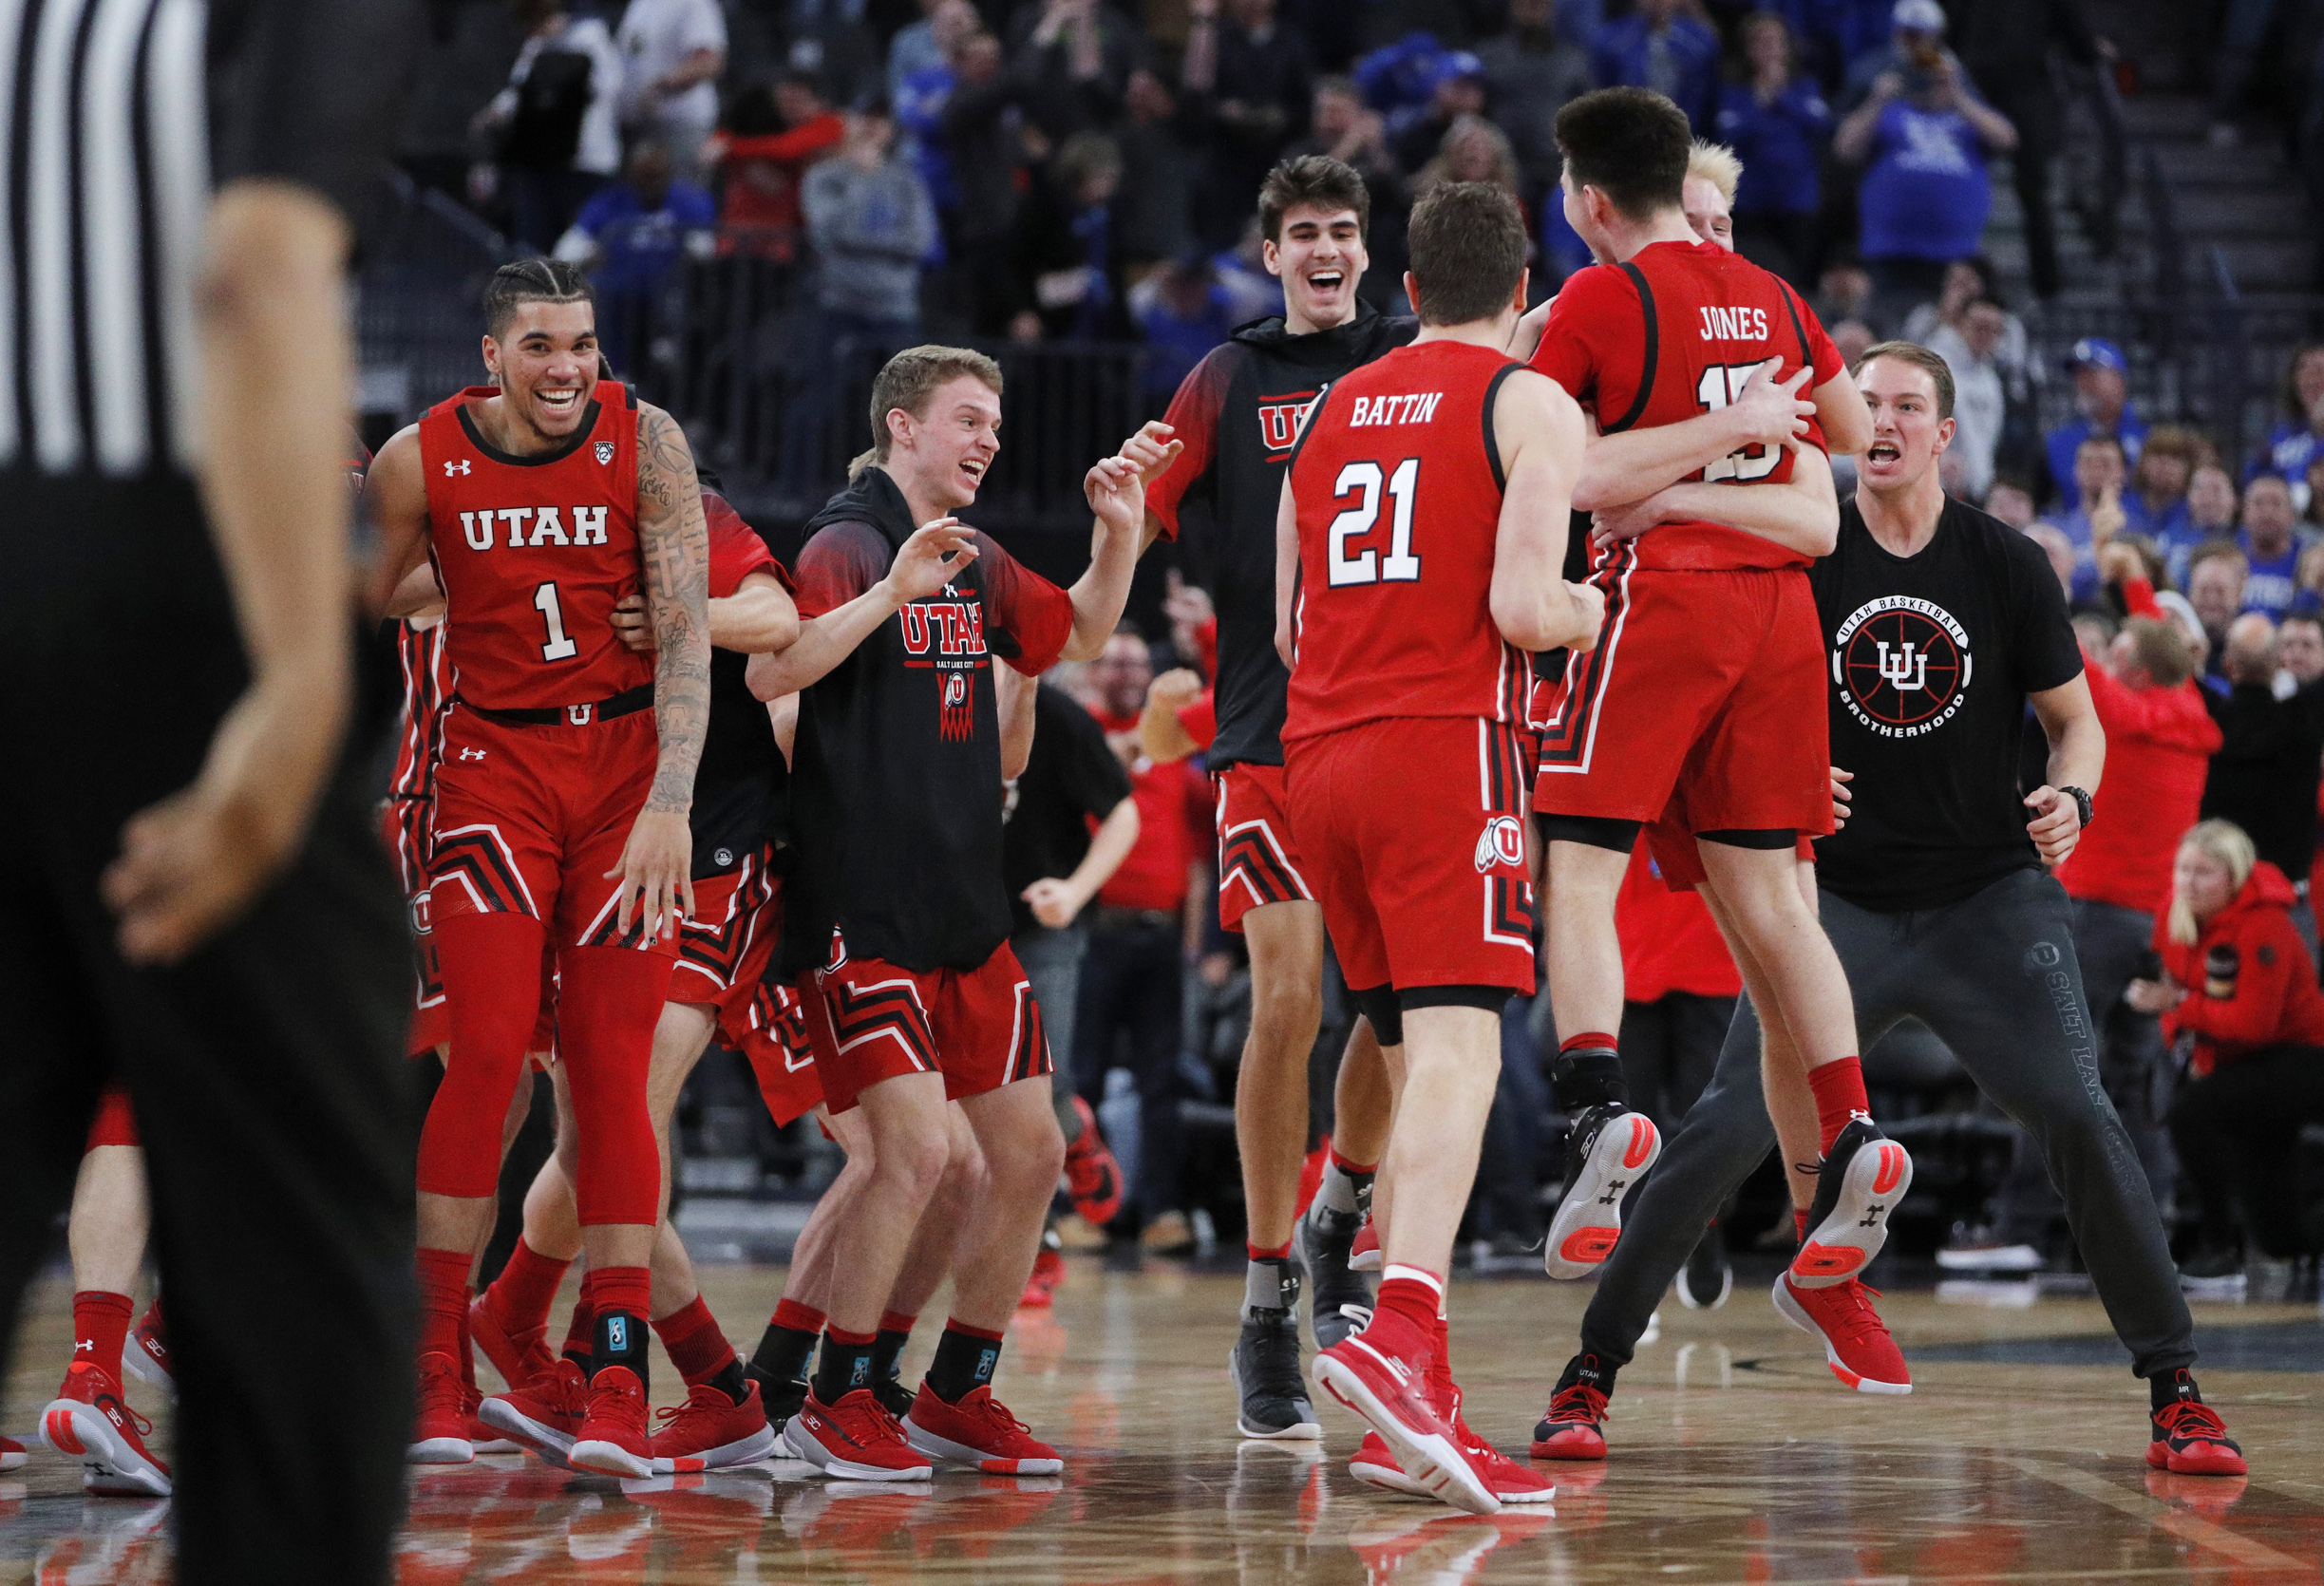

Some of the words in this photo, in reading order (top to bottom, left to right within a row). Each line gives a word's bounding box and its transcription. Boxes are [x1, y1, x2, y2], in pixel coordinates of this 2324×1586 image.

[1700, 306, 1768, 341] JONES
[1350, 392, 1443, 427] BATTIN
[598, 451, 609, 461] 12
[460, 505, 609, 551] UTAH
[1328, 457, 1422, 589] 21
[533, 580, 578, 663] 1
[898, 601, 988, 655] UTAH
[1840, 605, 1873, 637] UTAH
[1879, 597, 1963, 641] BASKETBALL
[936, 660, 950, 669] SALT
[567, 703, 593, 726] U
[1840, 689, 1964, 738] BROTHERHOOD
[1498, 826, 1520, 859] U
[2045, 972, 2087, 1039] SALT
[1579, 1369, 1599, 1379] UTAH
